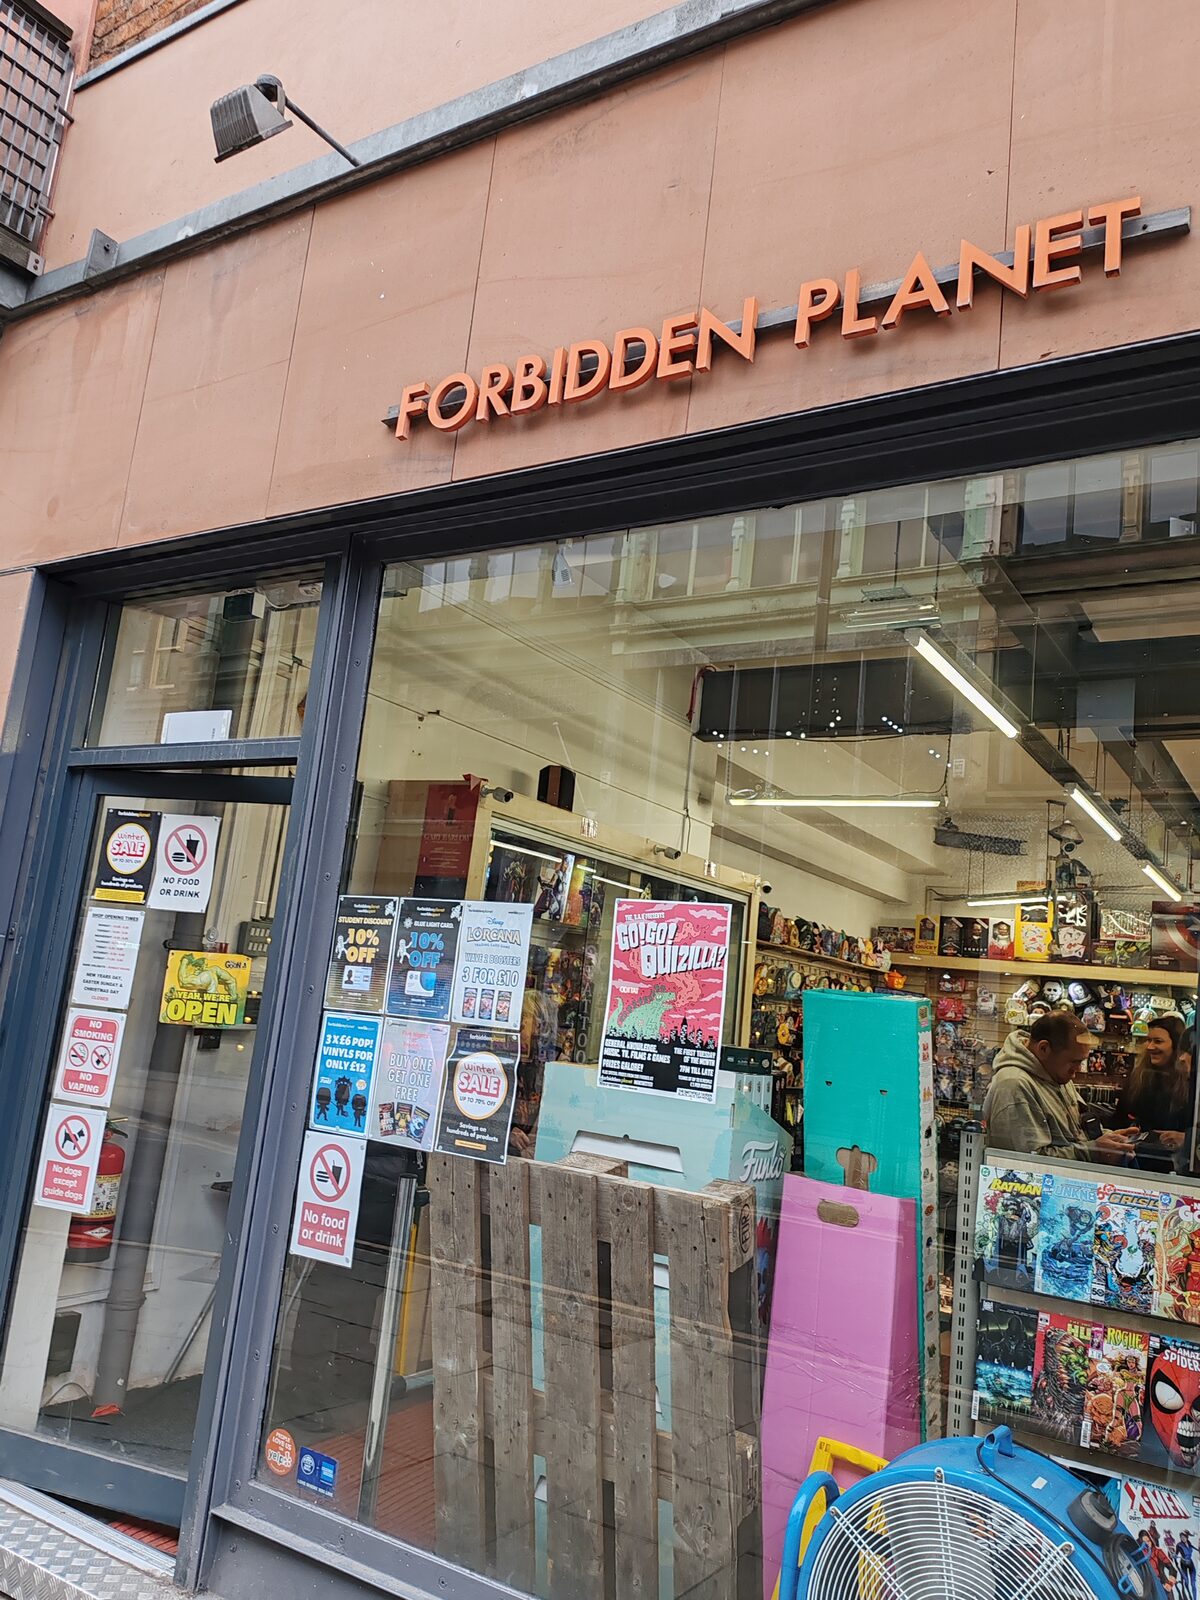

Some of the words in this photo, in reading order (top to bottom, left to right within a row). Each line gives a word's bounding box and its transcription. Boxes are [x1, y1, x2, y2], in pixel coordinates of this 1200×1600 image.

[395, 297, 758, 440] FORBIDDEN
[794, 196, 1141, 349] PLANET
[111, 840, 146, 857] SALE
[177, 877, 200, 886] FOOD
[159, 888, 172, 896] OR
[173, 889, 200, 898] DRINK
[338, 916, 363, 924] STUDENT
[363, 917, 393, 926] DISCOUNT
[348, 928, 379, 946] 10%
[410, 932, 444, 950] 10%
[467, 927, 521, 946] LORCANA
[346, 946, 376, 963] OFF
[409, 950, 441, 968] OFF
[465, 952, 483, 963] WAVE
[483, 954, 488, 963] 2
[489, 954, 521, 966] BOOSTERS
[462, 966, 470, 982] 3
[472, 967, 495, 985] FOR
[496, 969, 519, 987] £10
[203, 993, 231, 1002] WE'RE
[167, 999, 238, 1024] OPEN
[88, 1019, 103, 1029] NO
[73, 1028, 114, 1042] SMOKING
[325, 1034, 332, 1045] 3
[332, 1034, 339, 1045] X
[339, 1035, 351, 1046] £6
[352, 1037, 374, 1048] POP!
[323, 1046, 355, 1059] VINYLS
[355, 1050, 373, 1061] FOR
[630, 1051, 647, 1060] FILMS
[652, 1053, 671, 1064] GAMES
[690, 1056, 699, 1064] THE
[325, 1058, 350, 1070] ONLY
[350, 1061, 366, 1073] £12
[389, 1053, 410, 1069] BUY
[412, 1057, 433, 1073] ONE
[602, 1058, 620, 1069] PRIZES
[690, 1066, 701, 1075] TILL
[701, 1067, 714, 1076] LATE
[79, 1072, 93, 1081] NO
[388, 1069, 409, 1084] GET
[409, 1073, 431, 1088] ONE
[458, 1071, 501, 1098] SALE
[68, 1082, 100, 1094] VAPING
[395, 1085, 418, 1102] FREE
[446, 1126, 469, 1136] hundreds
[475, 1132, 498, 1142] products
[459, 1122, 478, 1131] Savings
[739, 1139, 786, 1183] Funko
[51, 1164, 64, 1173] No
[66, 1165, 83, 1179] dogs
[52, 1177, 78, 1189] except
[991, 1178, 1042, 1196] BATMAN
[43, 1185, 63, 1198] guide
[64, 1188, 84, 1202] dogs
[303, 1208, 319, 1224] No
[320, 1212, 346, 1230] food
[301, 1228, 313, 1240] or
[315, 1230, 343, 1248] drink
[1106, 1327, 1144, 1350] ROGUE
[1162, 1349, 1200, 1372] SPIDER
[272, 1436, 285, 1448] LOVE
[284, 1442, 292, 1450] US
[275, 1431, 291, 1442] PEOPLE
[267, 1448, 285, 1466] yelp
[1129, 1478, 1178, 1494] EXCEPTIONAL
[1124, 1481, 1191, 1519] X-MEN
